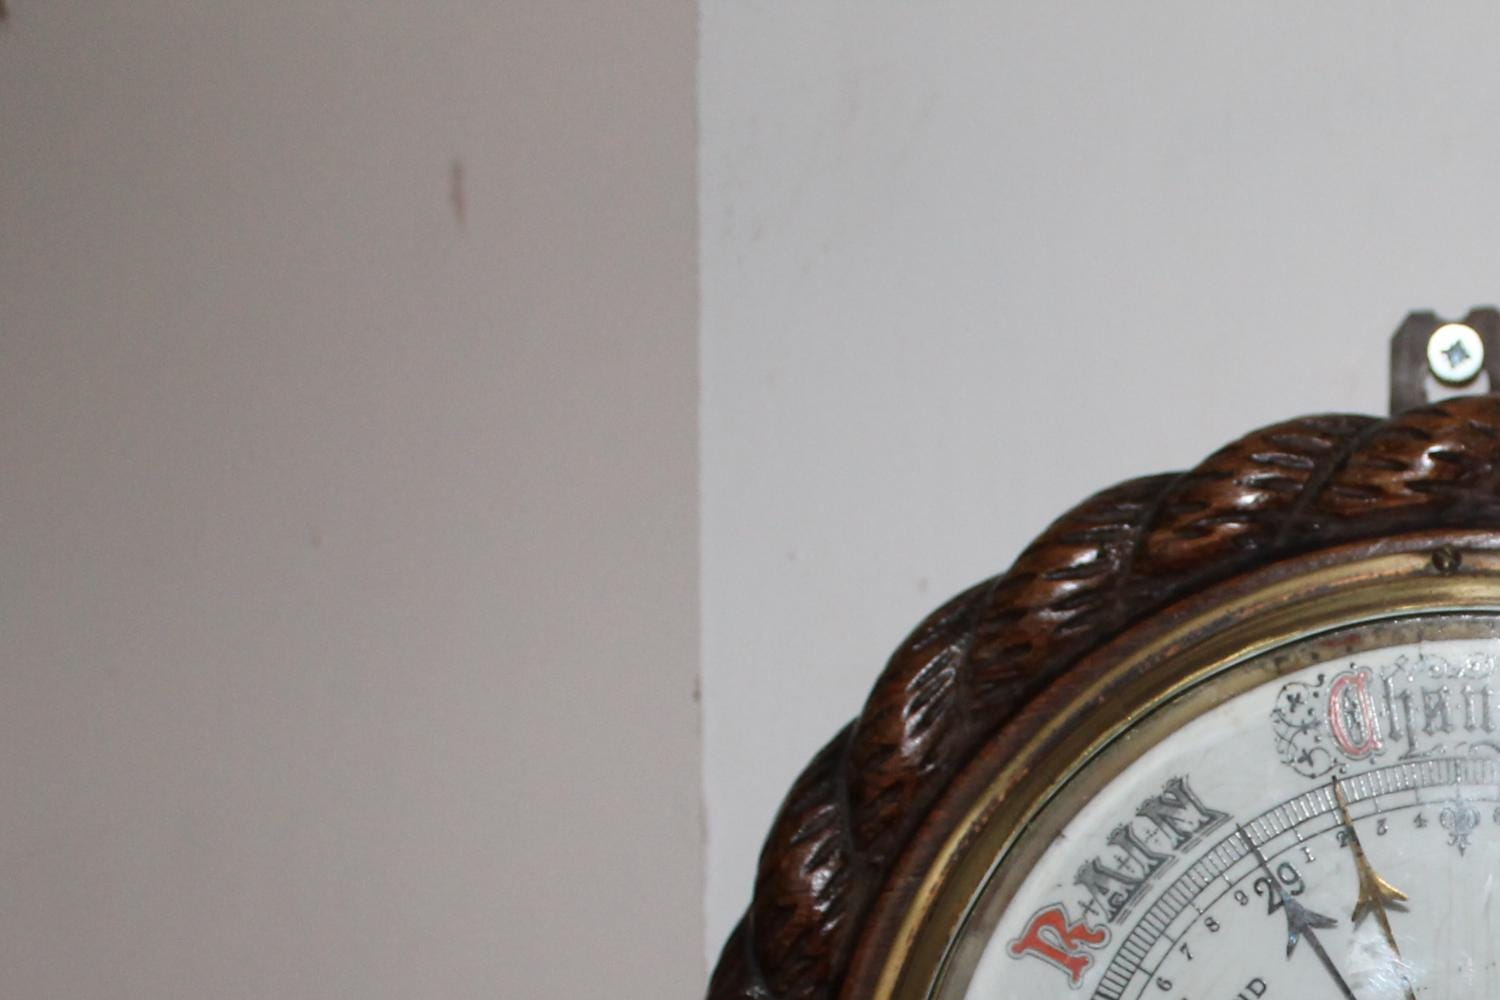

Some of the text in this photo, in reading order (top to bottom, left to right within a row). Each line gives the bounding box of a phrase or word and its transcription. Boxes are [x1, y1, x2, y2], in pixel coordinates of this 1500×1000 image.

[1377, 818, 1389, 836] 3
[1414, 813, 1427, 828] 4
[1304, 847, 1316, 862] 1
[1008, 774, 1233, 990] RAIN
[1254, 862, 1305, 915] 29
[1234, 890, 1249, 907] 9
[1206, 916, 1221, 934] 8
[1180, 944, 1194, 961] 7
[1157, 976, 1173, 993] 6
